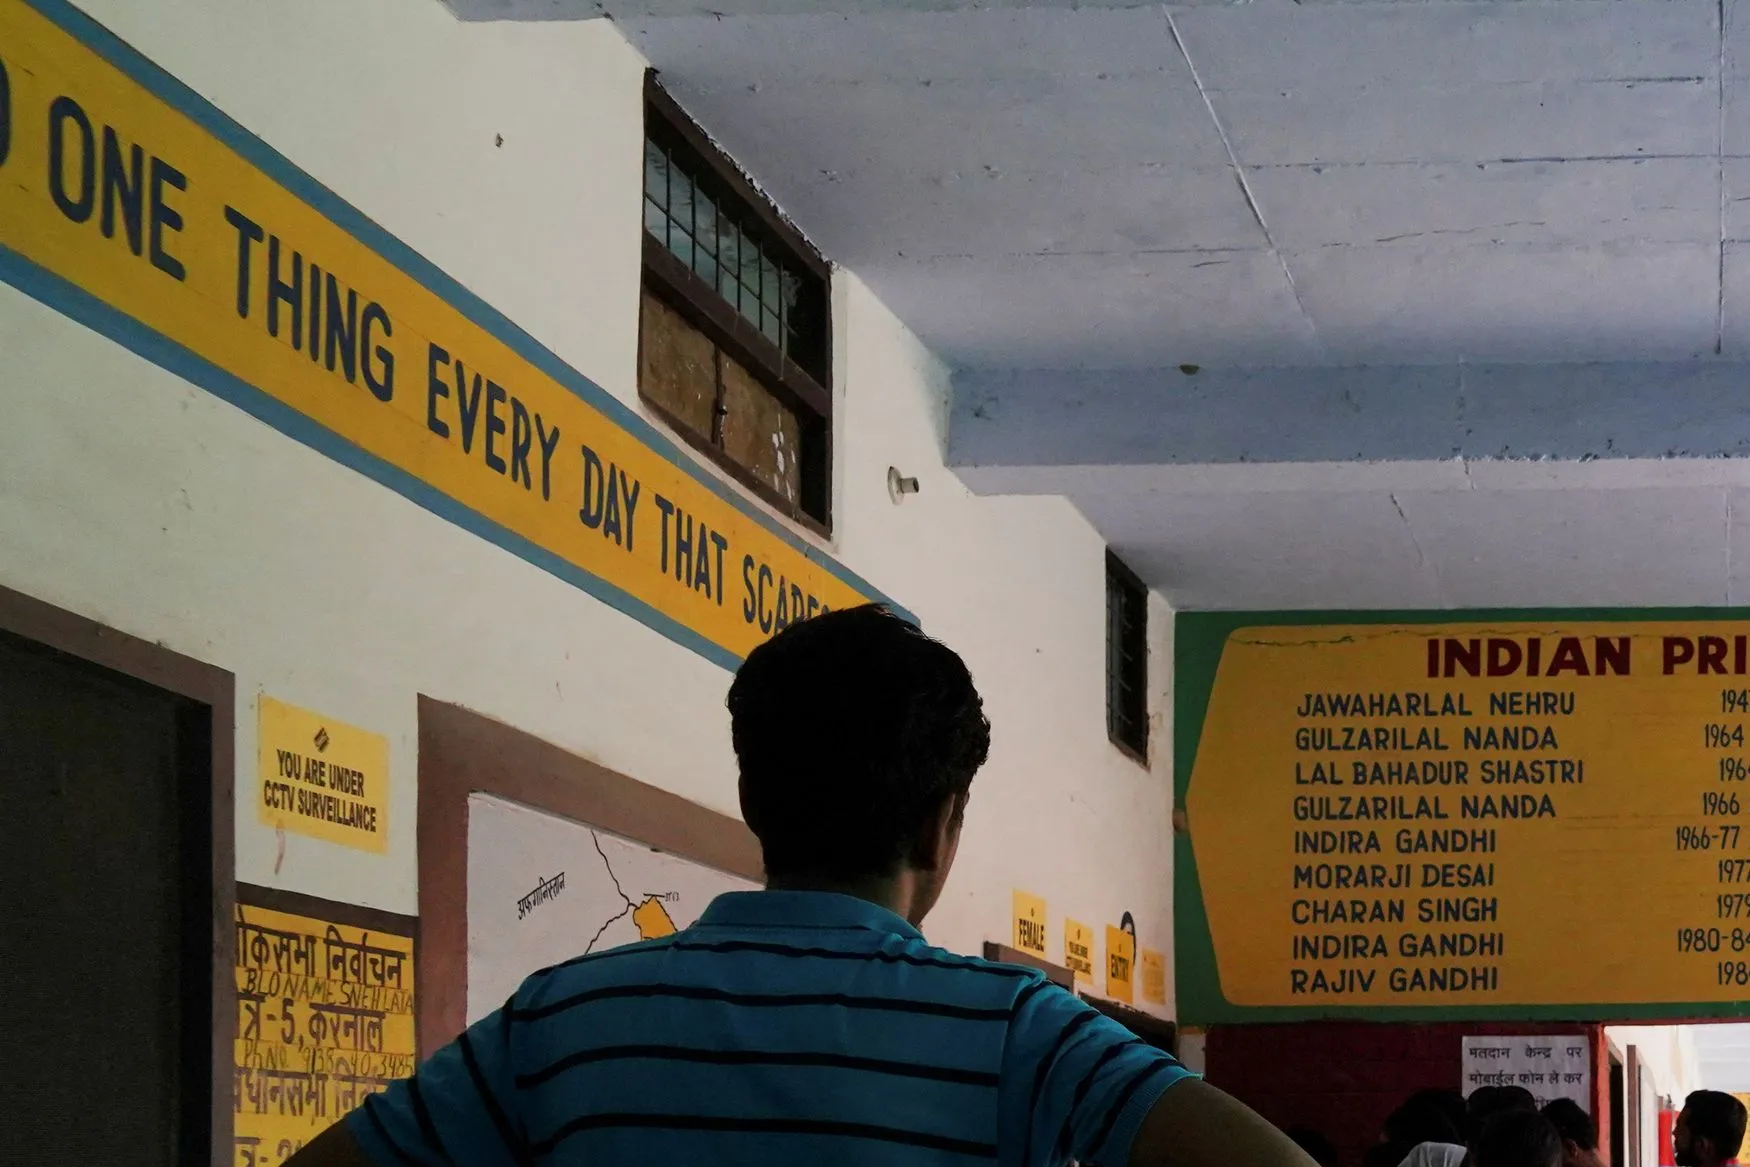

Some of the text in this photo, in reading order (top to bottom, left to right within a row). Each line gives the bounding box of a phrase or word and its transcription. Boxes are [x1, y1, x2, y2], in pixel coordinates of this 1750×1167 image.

[48, 96, 187, 283] ONE
[223, 204, 394, 403] THING
[427, 342, 561, 502] EVERY
[580, 444, 642, 552] DAY
[655, 493, 729, 607] THAT
[743, 554, 832, 635] SCAR
[1427, 636, 1630, 678] INDIAN
[1297, 692, 1575, 717] JAWAHARLAL NEHRU
[1295, 726, 1558, 751] GULZARILAL NANDA
[1704, 724, 1744, 749] 1964
[276, 748, 364, 798] YOU ARE UNDER
[1295, 759, 1583, 785] LAL BAHADUR SHASTRI
[264, 779, 377, 832] CCTV SURVEILLANCE
[1293, 794, 1556, 821] GULZARILAL NANDA
[1703, 791, 1740, 816] 1966
[1294, 829, 1496, 853] INDIRA GANDHI
[1676, 826, 1740, 850] 1966-77
[1293, 863, 1494, 889] MORARJI DESAI
[1292, 897, 1498, 924] CHARAN SINGH
[1018, 918, 1045, 952] FEMALE
[1293, 933, 1503, 960] INDIRA GANDHI
[323, 925, 406, 989] निर्वाचन
[1291, 967, 1497, 994] RAJIV GANDHI
[309, 1003, 386, 1053] करनाल
[1469, 1043, 1583, 1059] मतदान केन्द्र पर
[1518, 1070, 1544, 1085] फोन
[1548, 1070, 1559, 1084] ले
[1563, 1073, 1584, 1085] कर
